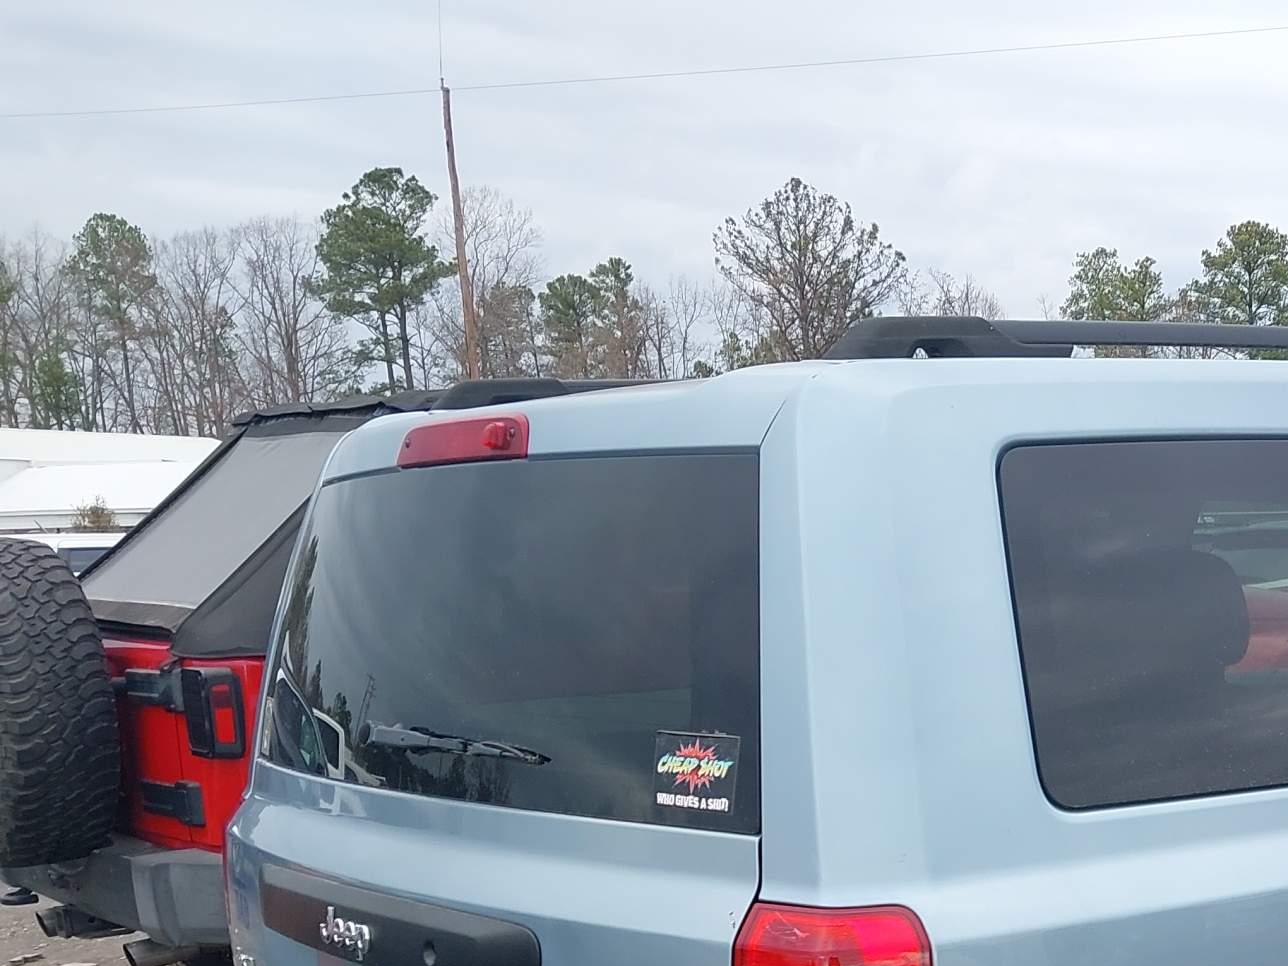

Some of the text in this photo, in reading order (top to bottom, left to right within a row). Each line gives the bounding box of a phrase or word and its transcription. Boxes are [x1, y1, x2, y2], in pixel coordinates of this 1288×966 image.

[657, 753, 700, 775] CHEAP
[656, 792, 675, 806] WHO
[675, 794, 700, 809] GIVES
[700, 797, 707, 810] A
[320, 906, 370, 961] Jeep
